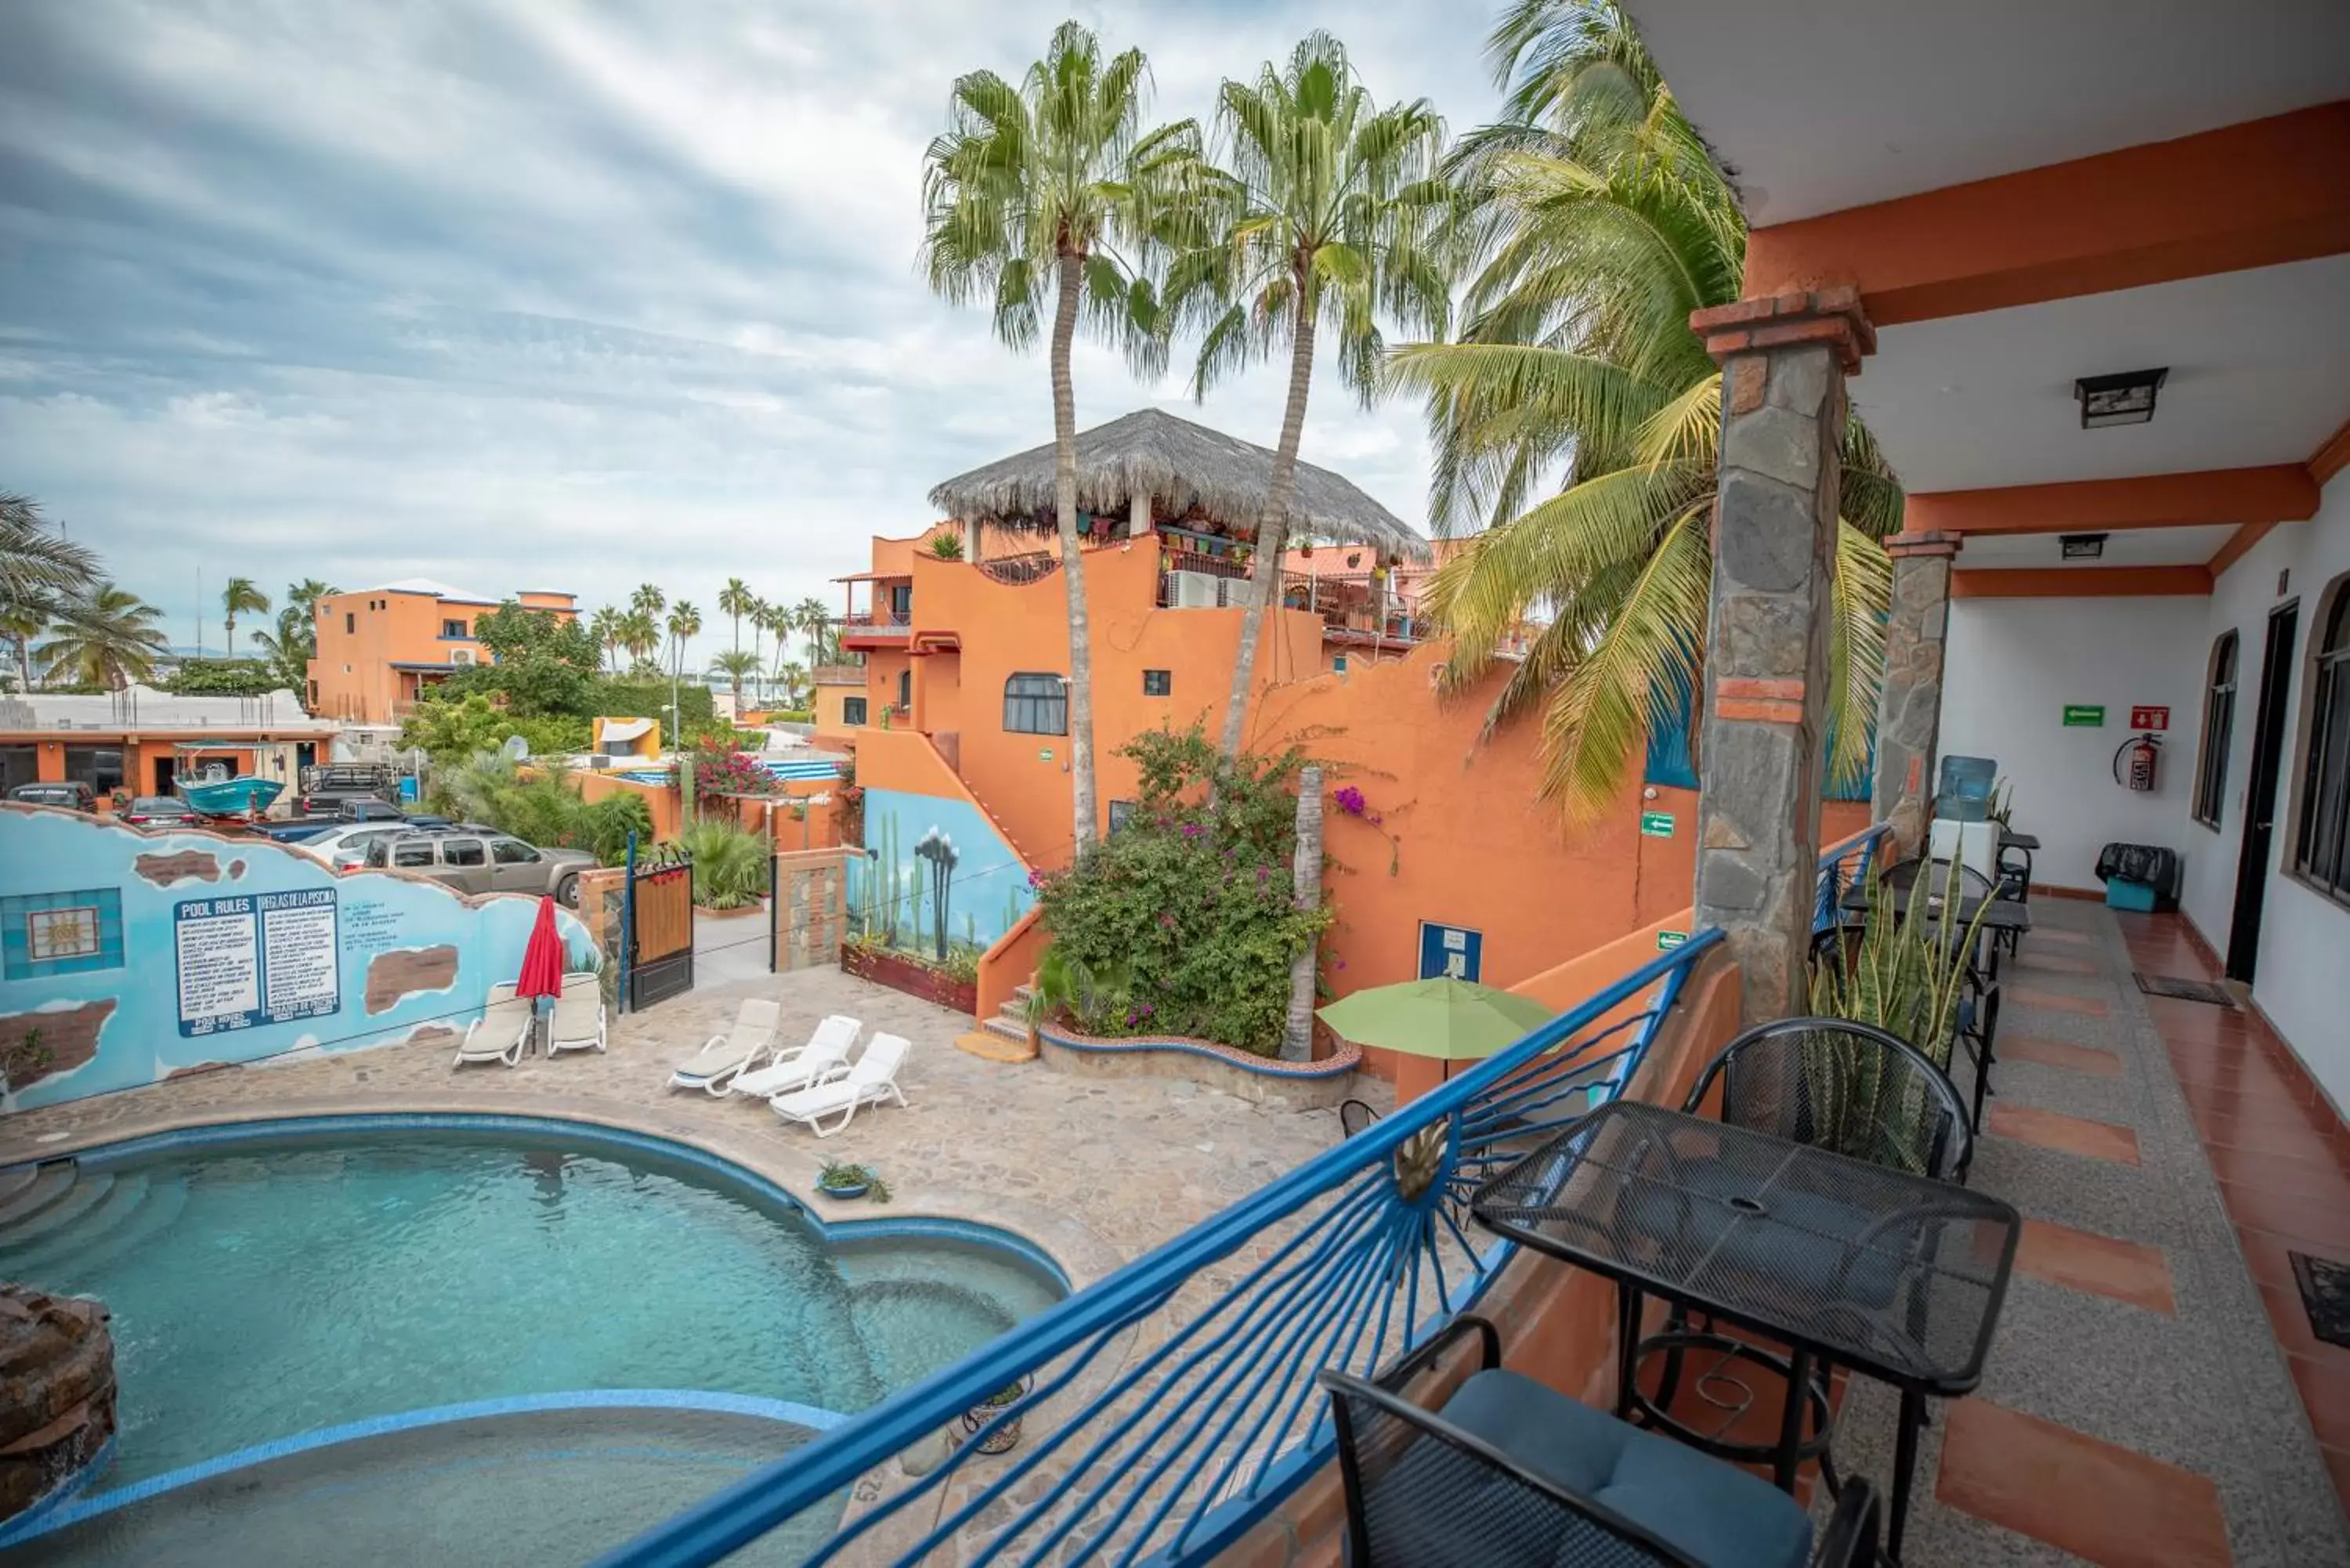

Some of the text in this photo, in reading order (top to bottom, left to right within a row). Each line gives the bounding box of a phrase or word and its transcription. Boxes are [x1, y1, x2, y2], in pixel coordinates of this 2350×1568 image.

[182, 898, 250, 918] POOL RULES
[262, 890, 336, 909] REGLAS DE LA PISCINA
